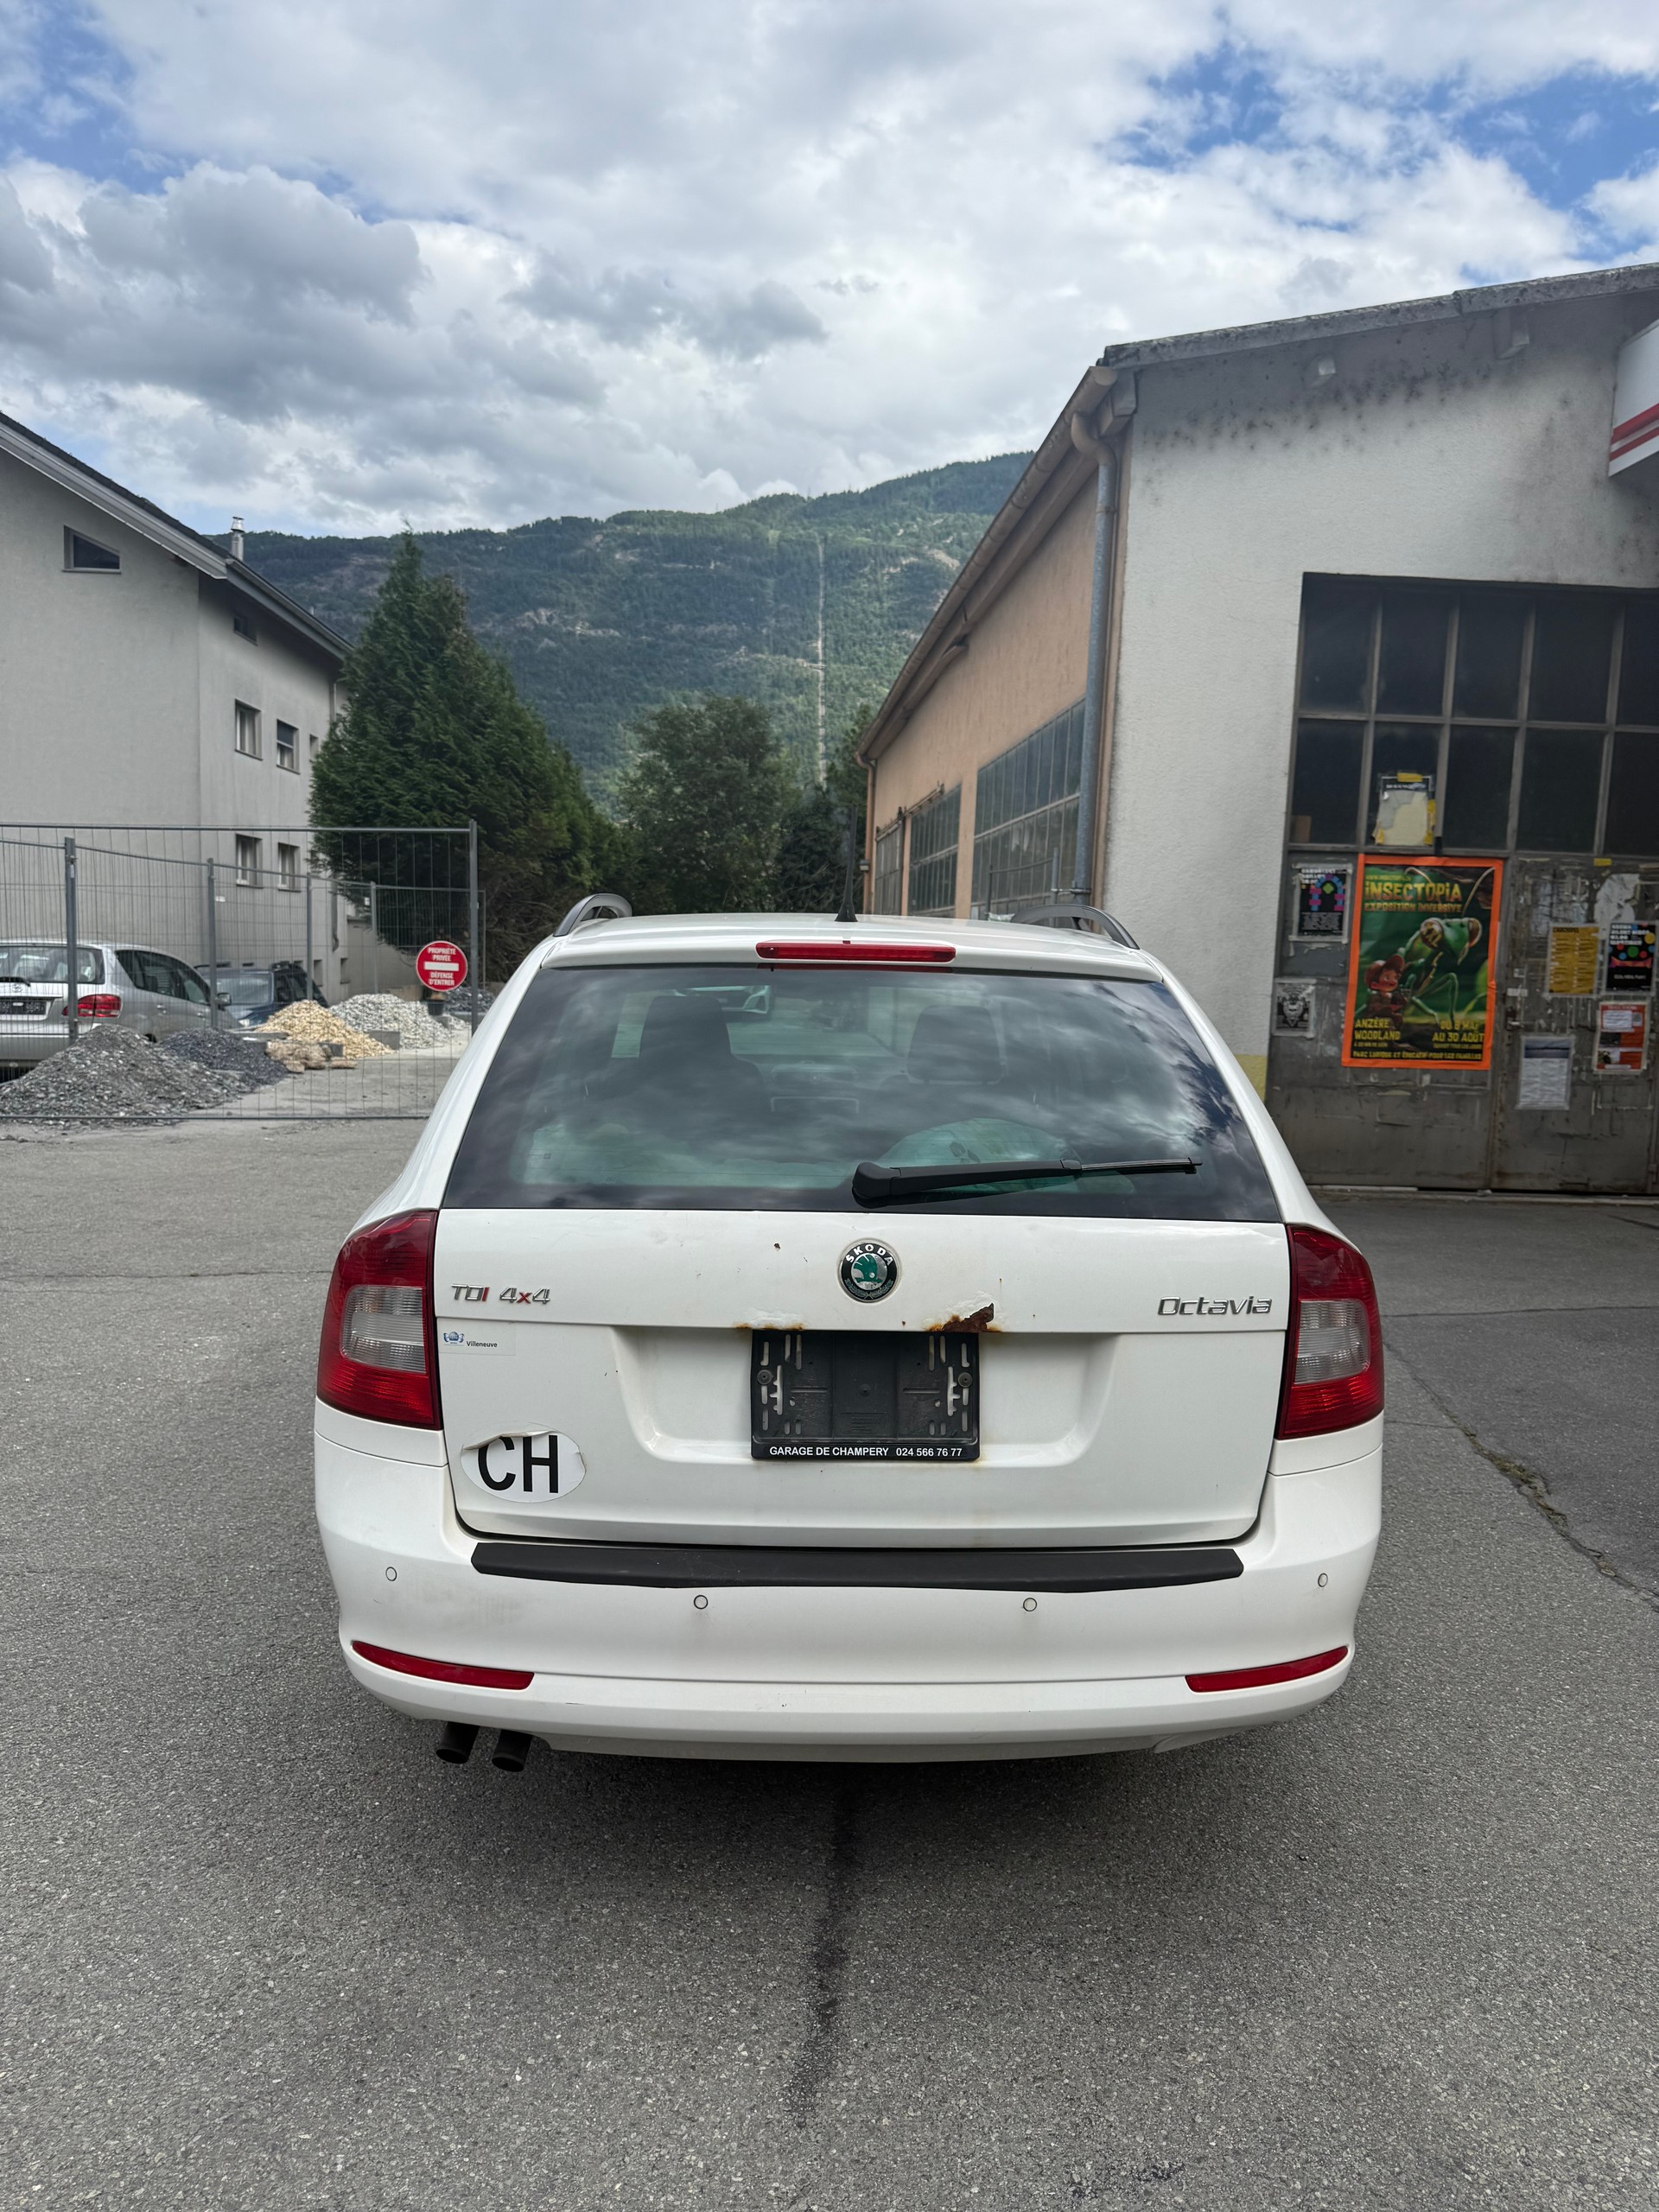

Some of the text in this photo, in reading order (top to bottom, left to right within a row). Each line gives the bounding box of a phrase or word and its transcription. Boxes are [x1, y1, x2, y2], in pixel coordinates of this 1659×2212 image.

[1355, 1017, 1389, 1028] ANZÈRE
[1354, 1029, 1401, 1040] WOODLAND
[1432, 1032, 1445, 1041] AU
[451, 1283, 550, 1305] TDI 4x4
[1158, 1296, 1272, 1315] Octavia
[769, 1446, 963, 1457] GARAGE DE CHAMPERY 024 566 76 77
[478, 1435, 559, 1494] CH
